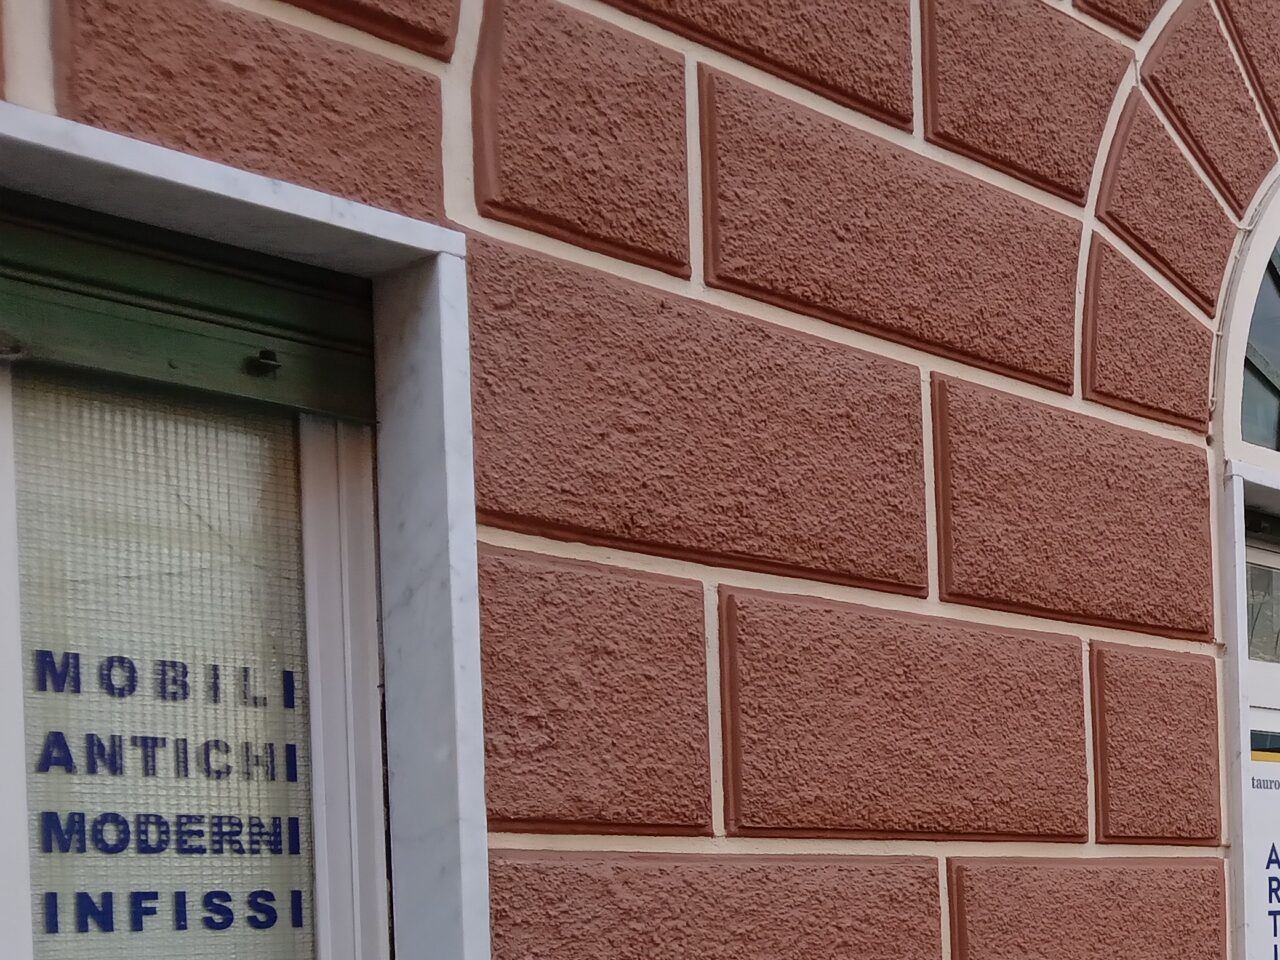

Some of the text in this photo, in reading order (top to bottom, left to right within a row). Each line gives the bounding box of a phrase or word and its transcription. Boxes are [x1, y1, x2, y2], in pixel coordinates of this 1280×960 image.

[35, 649, 296, 709] MOBILI
[37, 731, 298, 783] ANTICHI
[1251, 775, 1280, 790] tauro
[40, 811, 300, 855] MODERNI
[45, 889, 304, 934] INFISSI
